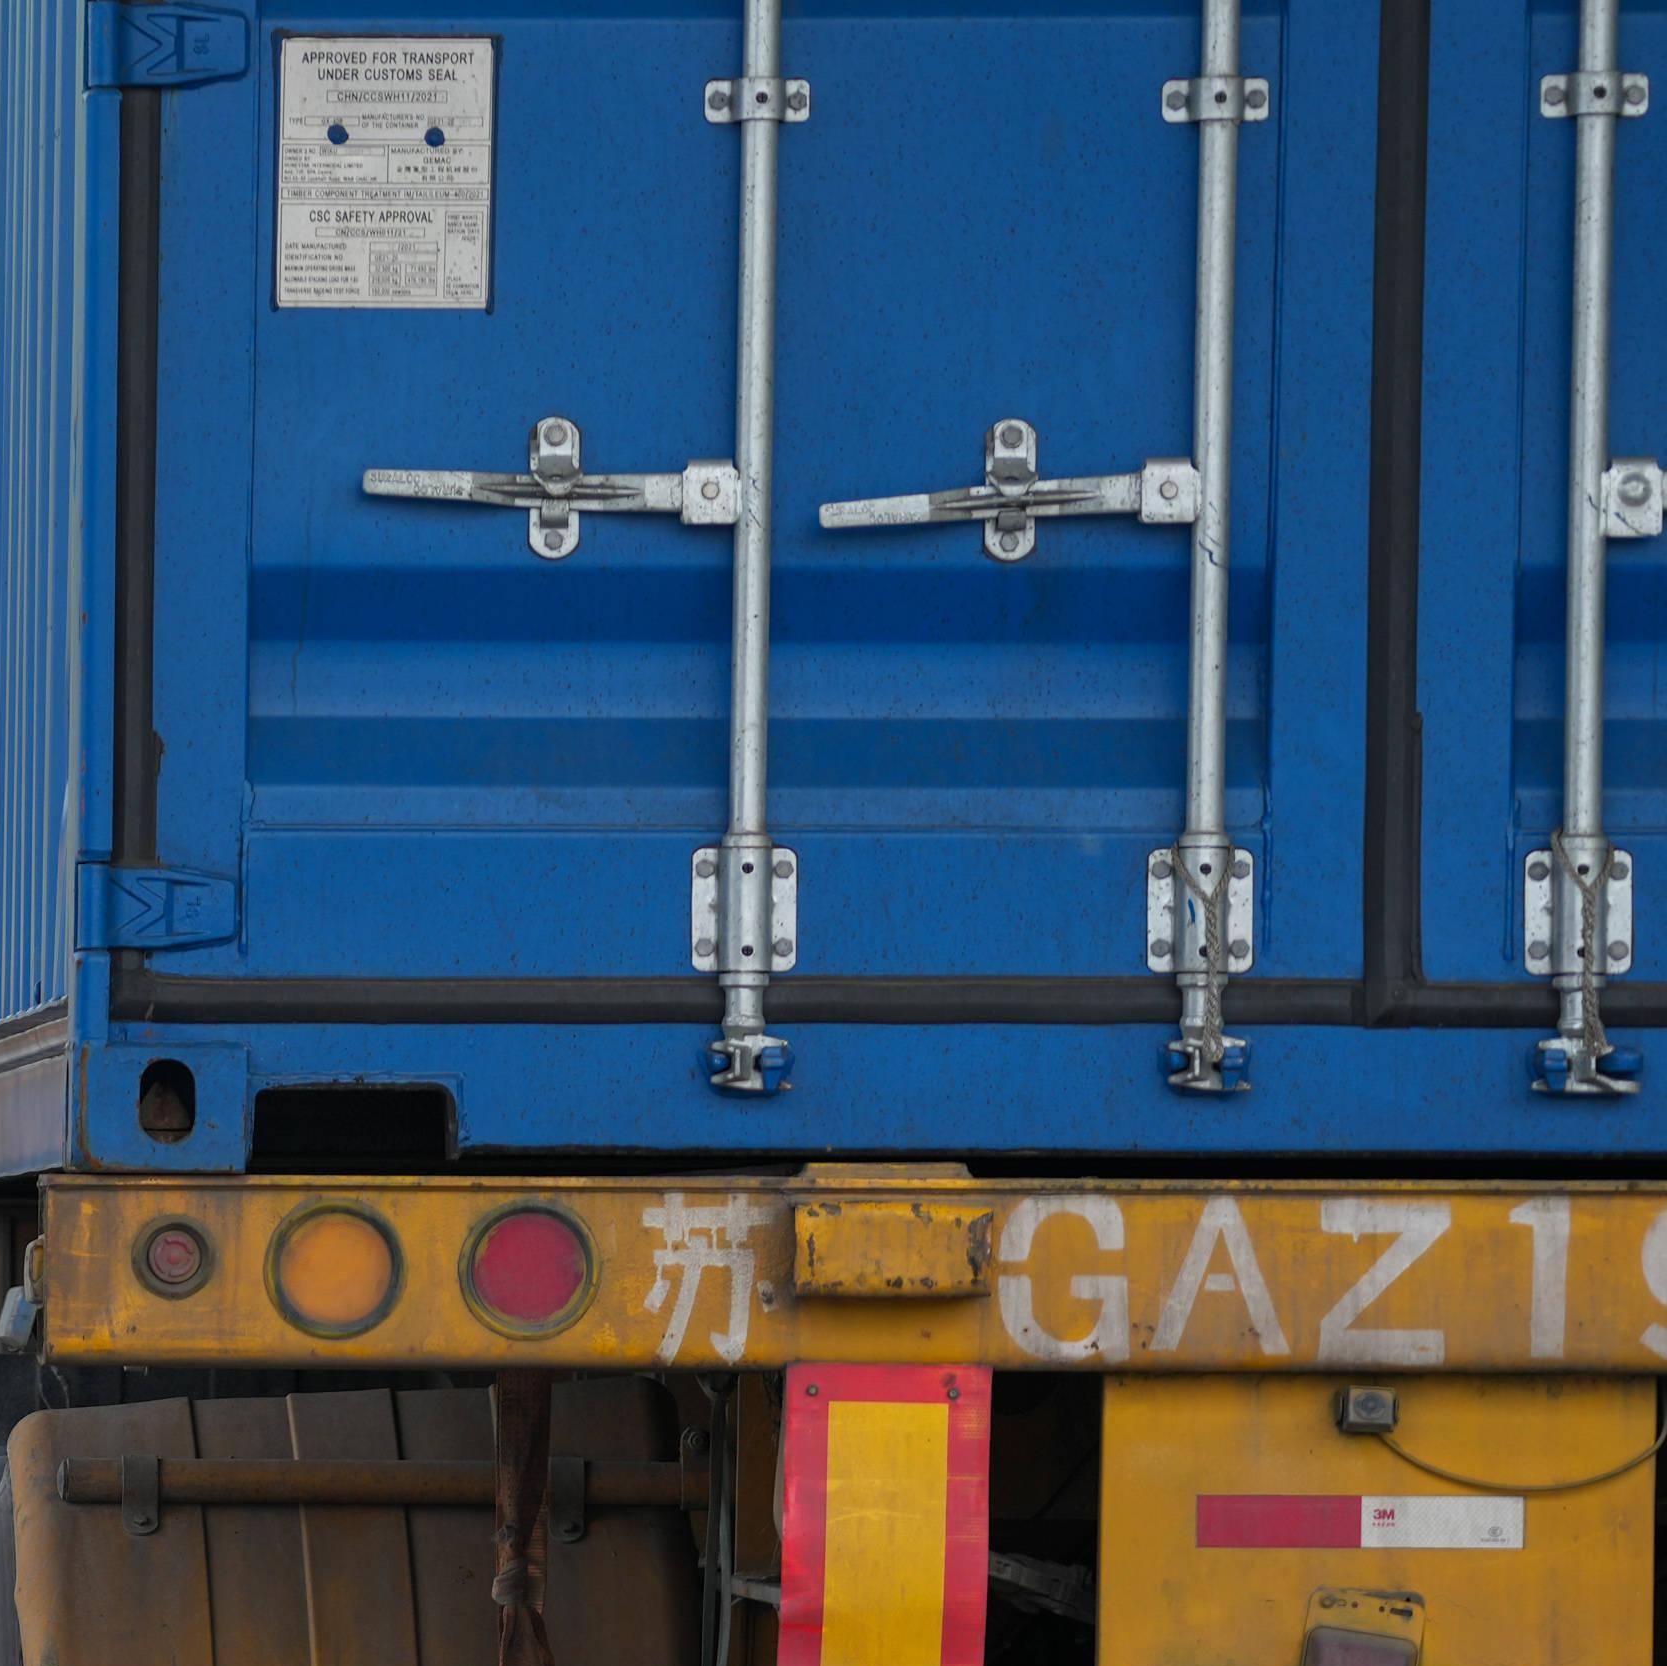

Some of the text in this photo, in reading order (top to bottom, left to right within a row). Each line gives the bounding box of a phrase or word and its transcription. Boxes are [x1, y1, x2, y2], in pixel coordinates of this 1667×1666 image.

[302, 52, 474, 64] APPROVED FOR TRANSPORT
[317, 69, 457, 81] UNDER CUSTOMS SEAL
[309, 210, 433, 224] CSC SAFETY APPROVAL
[642, 1191, 781, 1367] 苏
[1372, 1508, 1395, 1521] 3M
